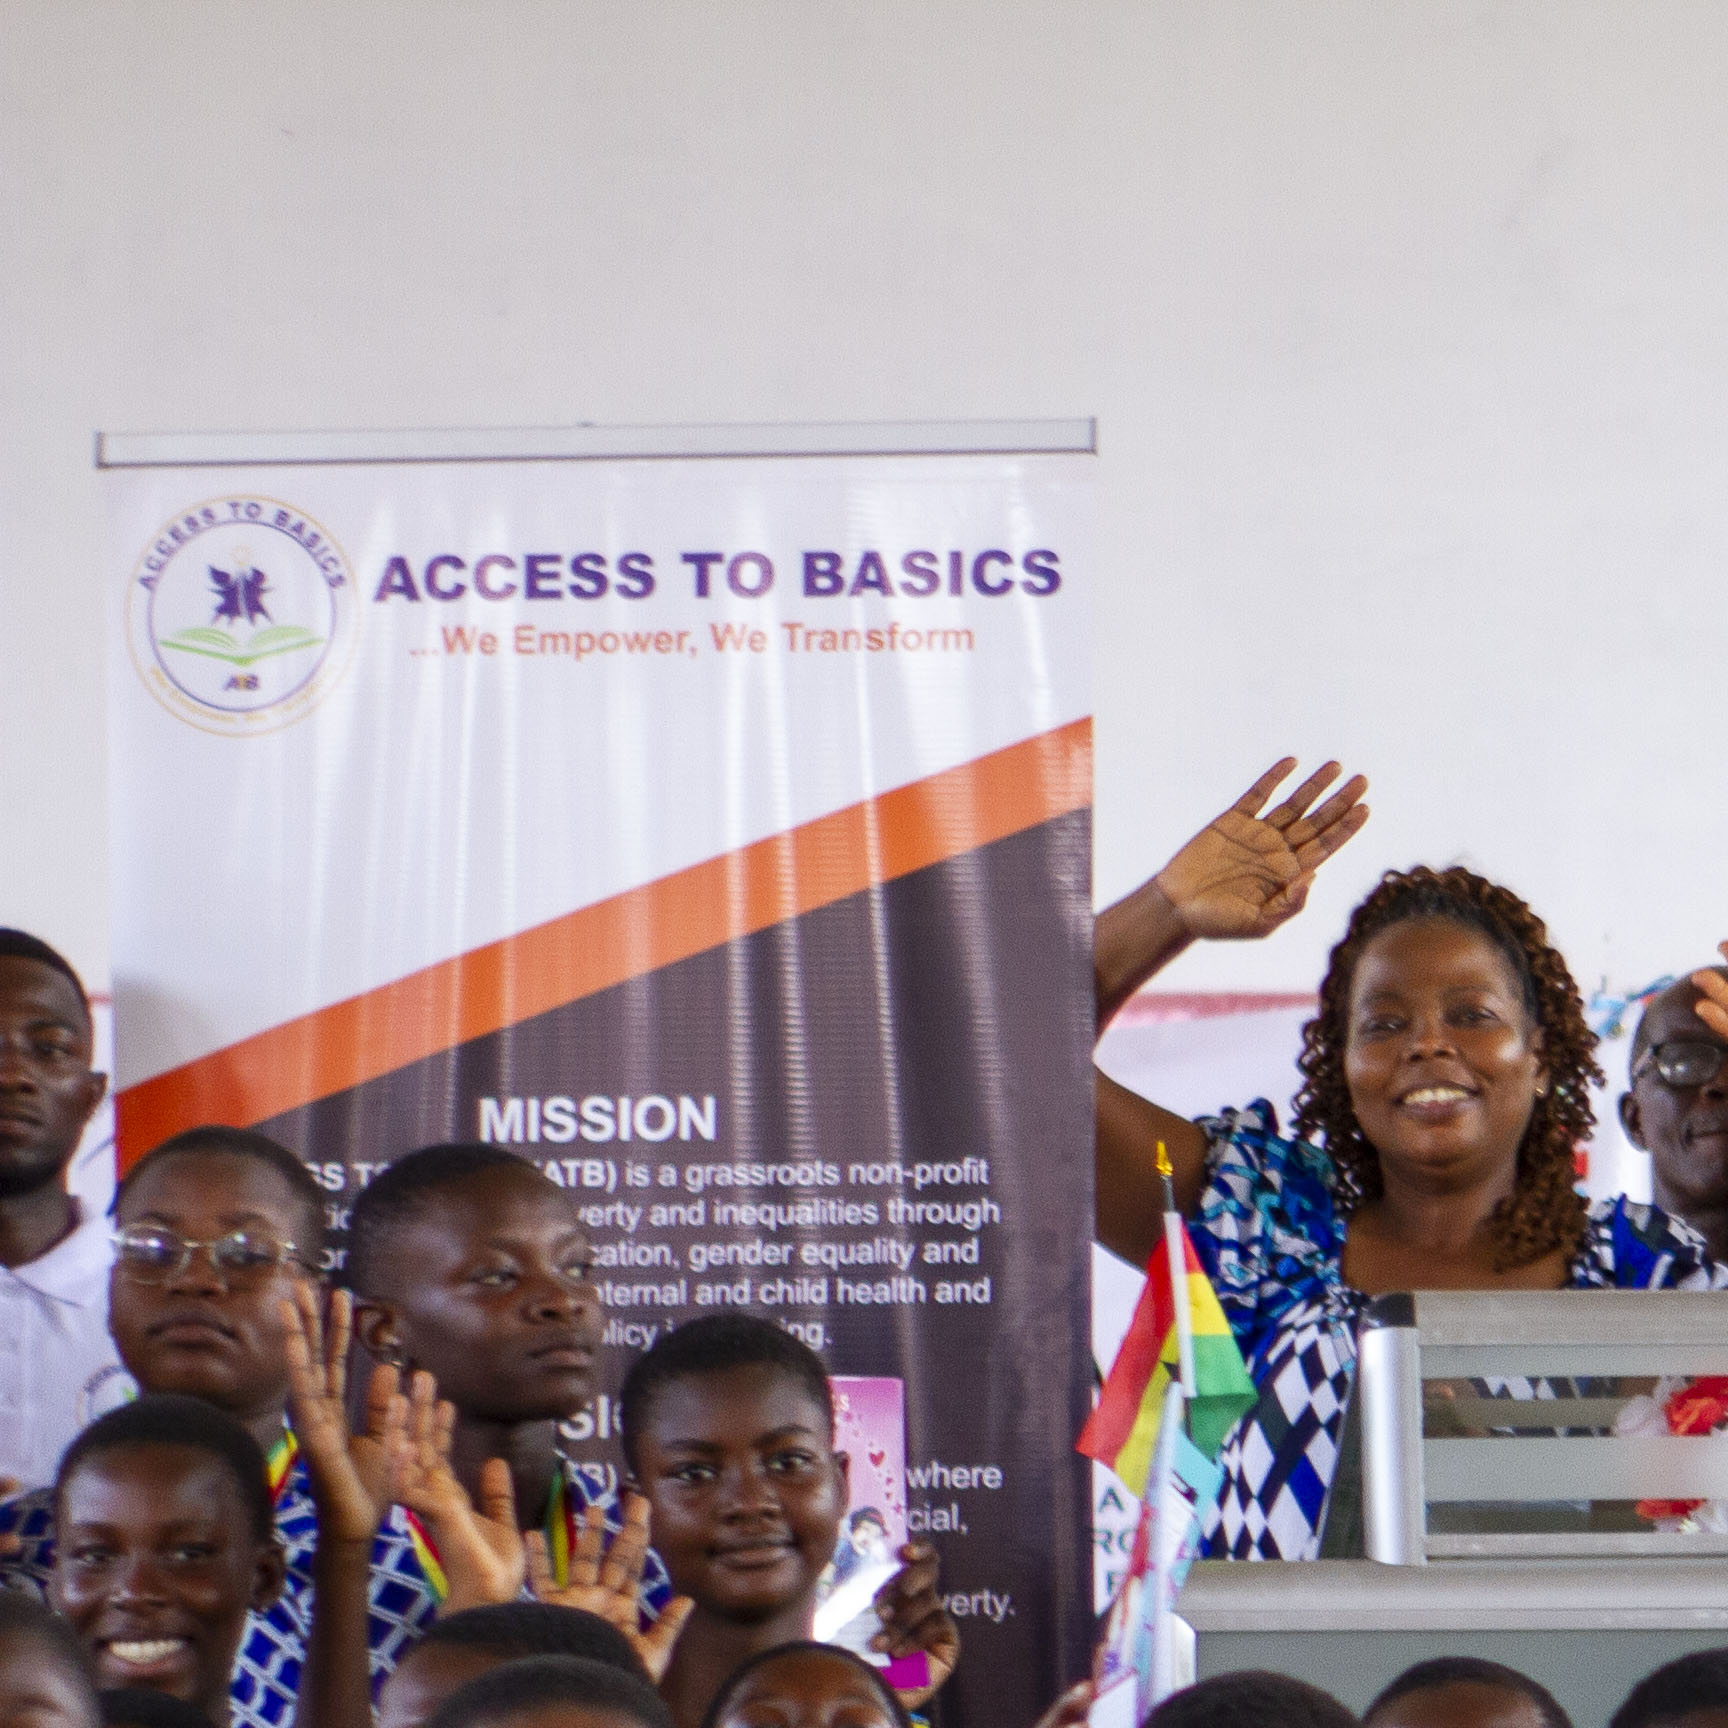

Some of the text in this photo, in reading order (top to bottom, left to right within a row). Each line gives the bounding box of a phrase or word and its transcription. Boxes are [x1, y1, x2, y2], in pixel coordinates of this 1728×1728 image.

[138, 508, 215, 591] ACCESS
[228, 501, 263, 519] TO
[374, 548, 1062, 602] ACCESS TO BASICS
[513, 623, 698, 662] Empower,
[709, 623, 769, 653] We
[781, 621, 976, 653] Transform
[479, 1095, 717, 1144] MISSION
[536, 1159, 617, 1193] ATB)
[625, 1160, 650, 1187] is
[658, 1166, 679, 1187] a
[684, 1161, 841, 1193] grassroots
[848, 1155, 991, 1192] non-profit
[578, 1198, 1001, 1233] erty and inequalities through
[593, 1237, 981, 1273] ation, gender equality and
[694, 1278, 751, 1306] and
[758, 1276, 829, 1305] child
[837, 1276, 928, 1305] health
[934, 1276, 993, 1305] and
[907, 1460, 1004, 1490] where
[907, 1502, 970, 1535] cial,
[940, 1589, 1018, 1624] erty.
